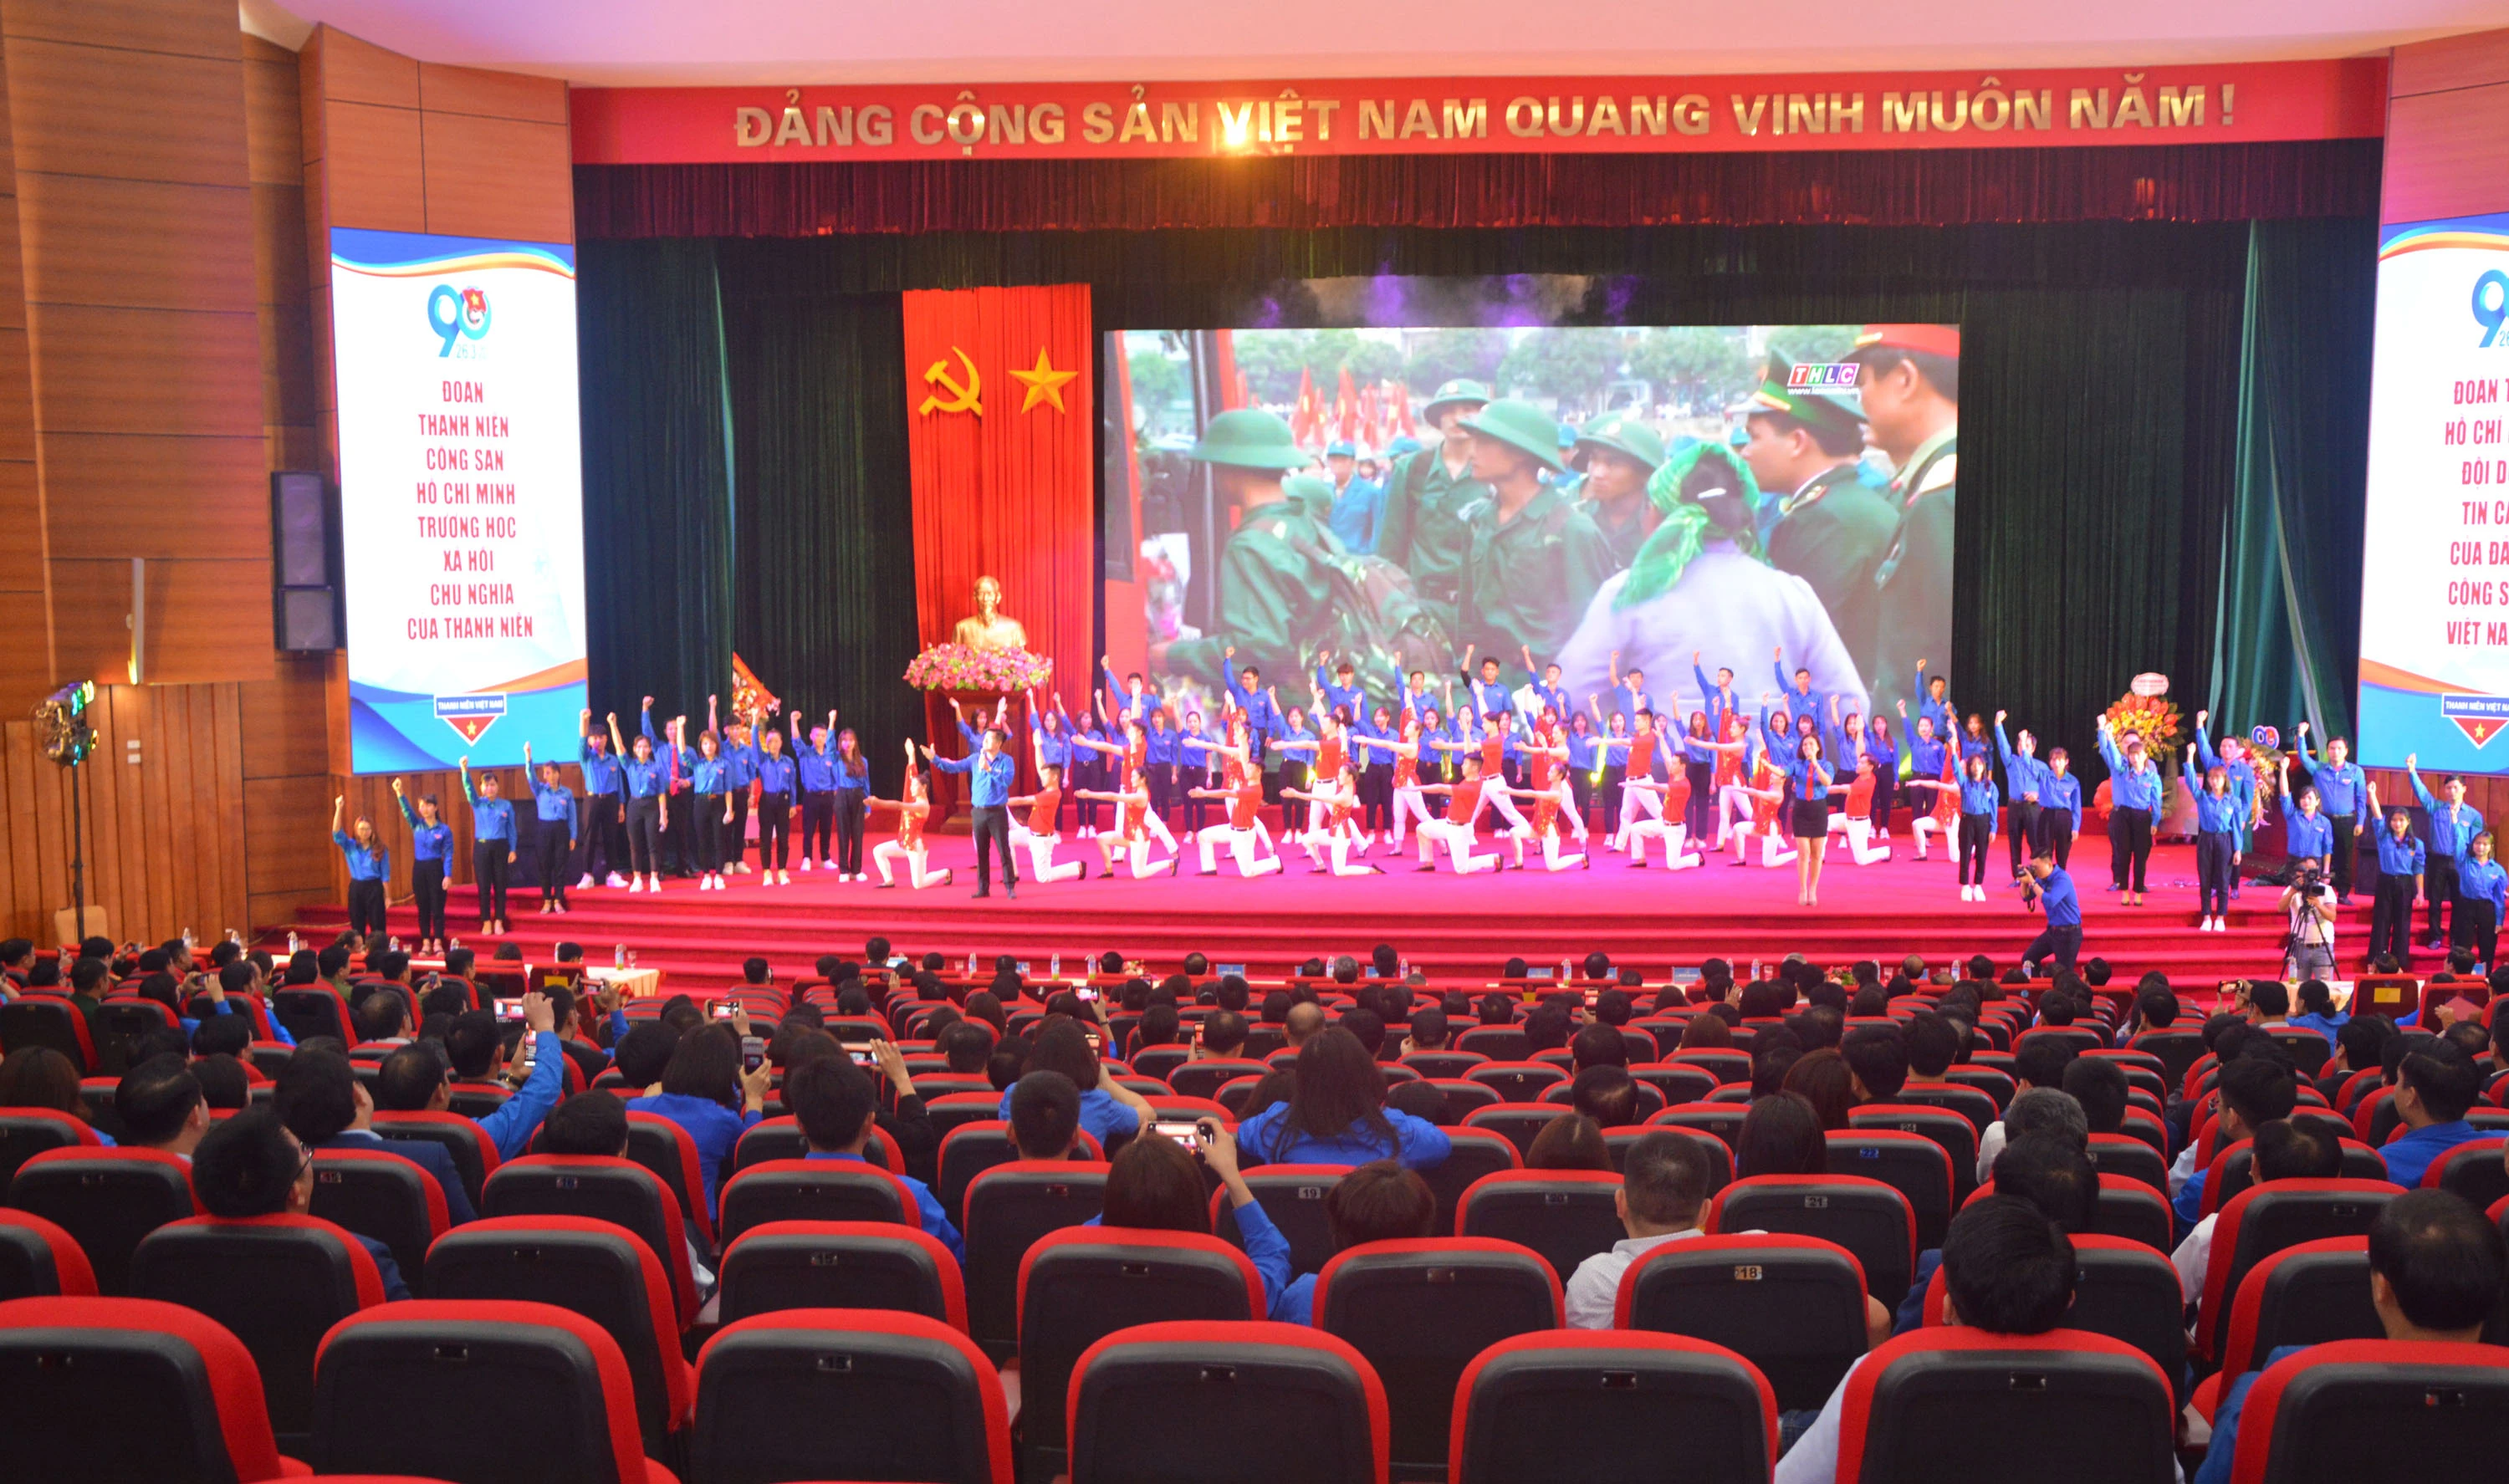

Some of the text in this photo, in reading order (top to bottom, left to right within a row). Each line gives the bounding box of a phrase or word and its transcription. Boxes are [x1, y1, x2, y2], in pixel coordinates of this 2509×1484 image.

[734, 74, 2235, 155] ĐẢNG CỘNG SẢN VIỆT NAM QUANG VINH MUÔN NĂM !
[2471, 268, 2509, 348] 9
[1791, 365, 1855, 385] THLC
[418, 414, 468, 436] THANH
[477, 482, 515, 504] MINH
[2462, 501, 2487, 525] TIN
[444, 616, 494, 639] THANH
[2487, 621, 2509, 645] NA
[1303, 1189, 1317, 1198] 19
[1808, 1196, 1823, 1206] 21
[1740, 1267, 1757, 1278] 18
